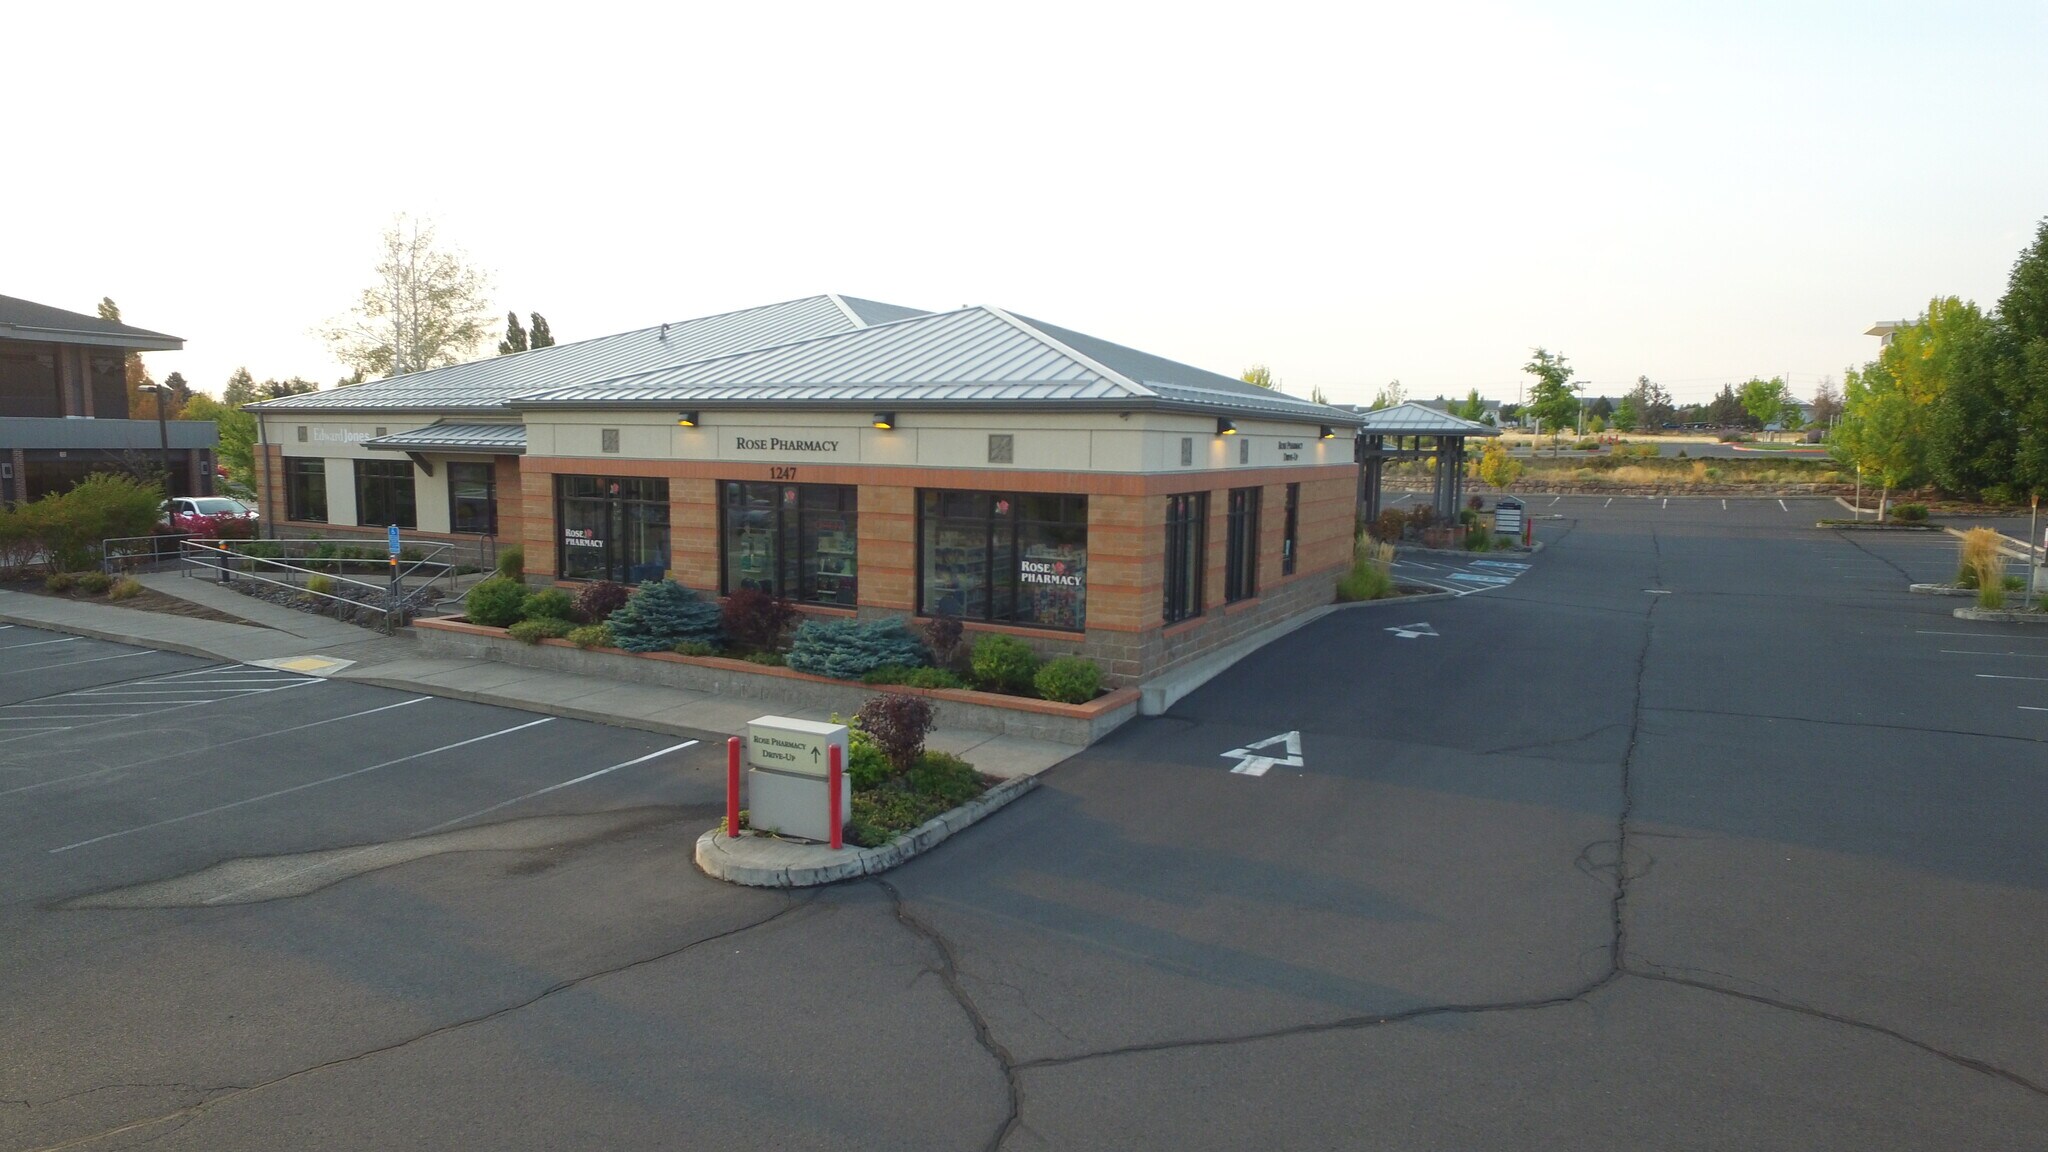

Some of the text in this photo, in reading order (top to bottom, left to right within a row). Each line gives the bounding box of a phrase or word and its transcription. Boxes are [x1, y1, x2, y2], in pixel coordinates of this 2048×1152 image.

[736, 437, 839, 451] ROSE PHARMACY
[770, 467, 797, 480] 1247
[565, 528, 584, 538] ROSE
[565, 537, 604, 548] PHARMACY
[1021, 560, 1050, 573] ROSE
[1021, 572, 1082, 586] PHARMACY
[771, 737, 806, 750] PHARMACY
